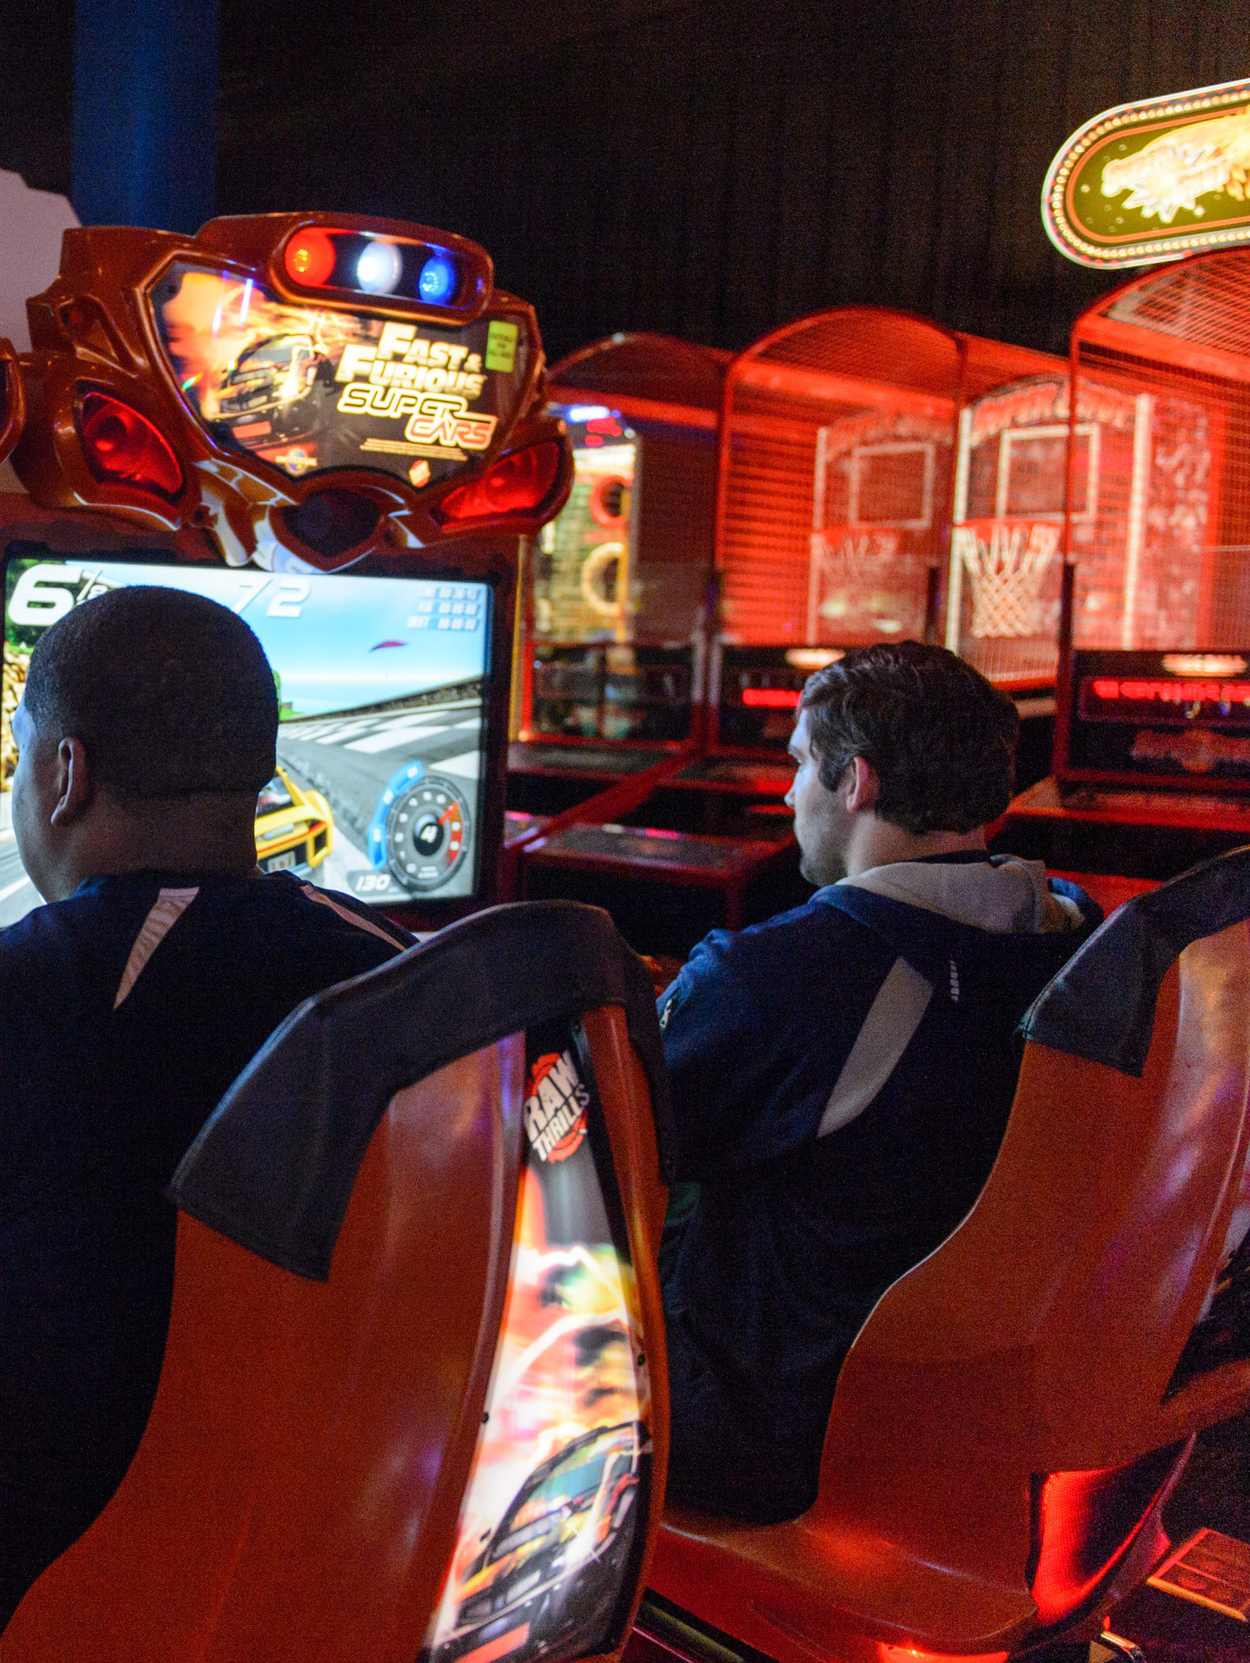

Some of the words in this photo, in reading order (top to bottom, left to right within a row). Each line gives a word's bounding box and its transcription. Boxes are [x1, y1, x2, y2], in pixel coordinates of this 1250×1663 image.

[334, 344, 485, 400] FURIOUS
[376, 321, 469, 371] FAST
[338, 383, 496, 423] SUPER
[405, 414, 497, 450] CARS
[523, 1049, 579, 1143] RAW
[532, 1083, 590, 1162] THRILLS
